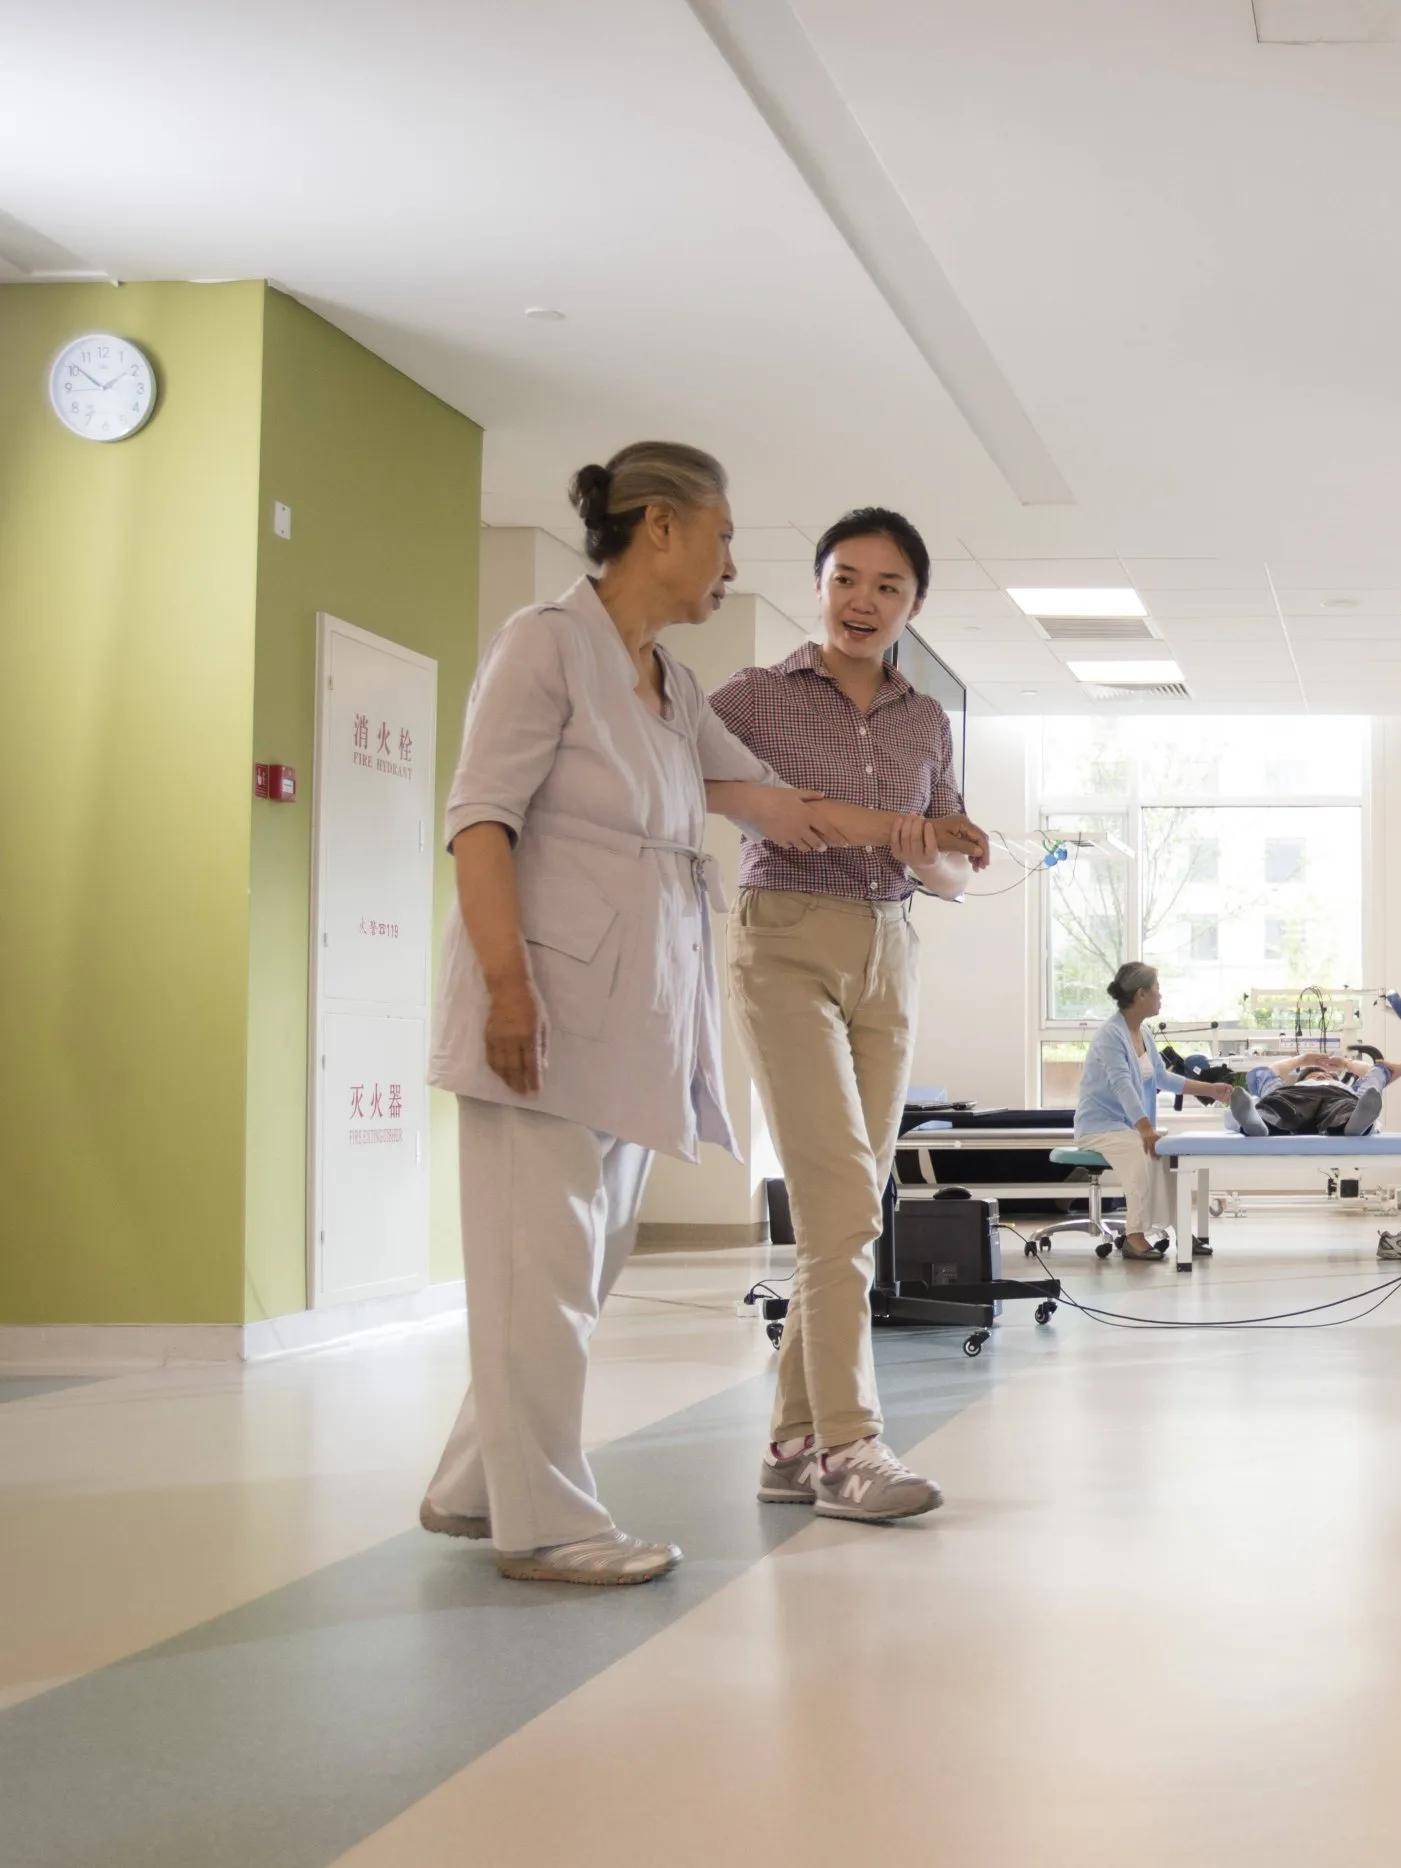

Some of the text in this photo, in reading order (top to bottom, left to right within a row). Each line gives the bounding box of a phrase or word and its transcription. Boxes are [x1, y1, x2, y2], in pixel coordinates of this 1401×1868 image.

[82, 351, 91, 363] 11
[97, 346, 110, 358] 12
[120, 351, 124, 363] 1
[68, 365, 80, 377] 10
[130, 364, 139, 377] 2
[64, 382, 72, 393] 9
[136, 382, 145, 395] 3
[71, 401, 80, 414] 8
[132, 401, 140, 414] 4
[353, 712, 413, 762] 消火栓
[353, 751, 412, 780] FIRE HYDRANT
[349, 1082, 402, 1120] 灭火器
